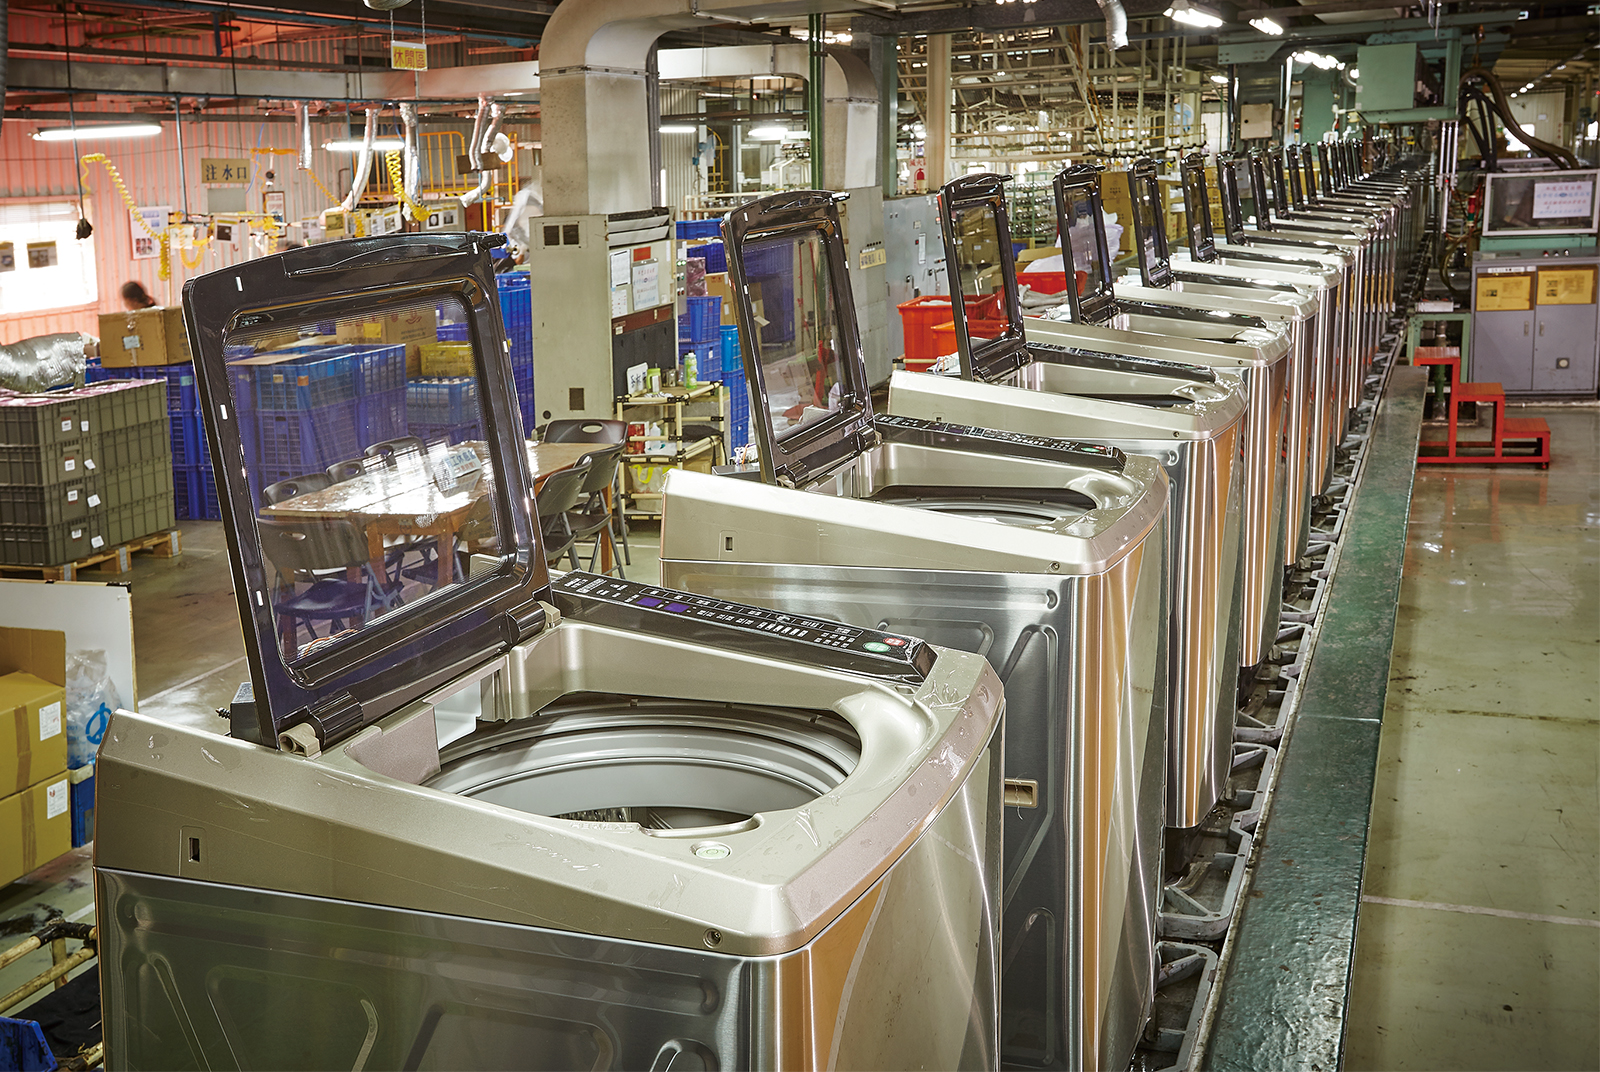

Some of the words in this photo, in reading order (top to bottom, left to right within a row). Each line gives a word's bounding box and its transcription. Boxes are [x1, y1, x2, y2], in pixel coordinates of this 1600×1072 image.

[393, 48, 426, 68] 休閒區
[206, 163, 247, 181] 注水口
